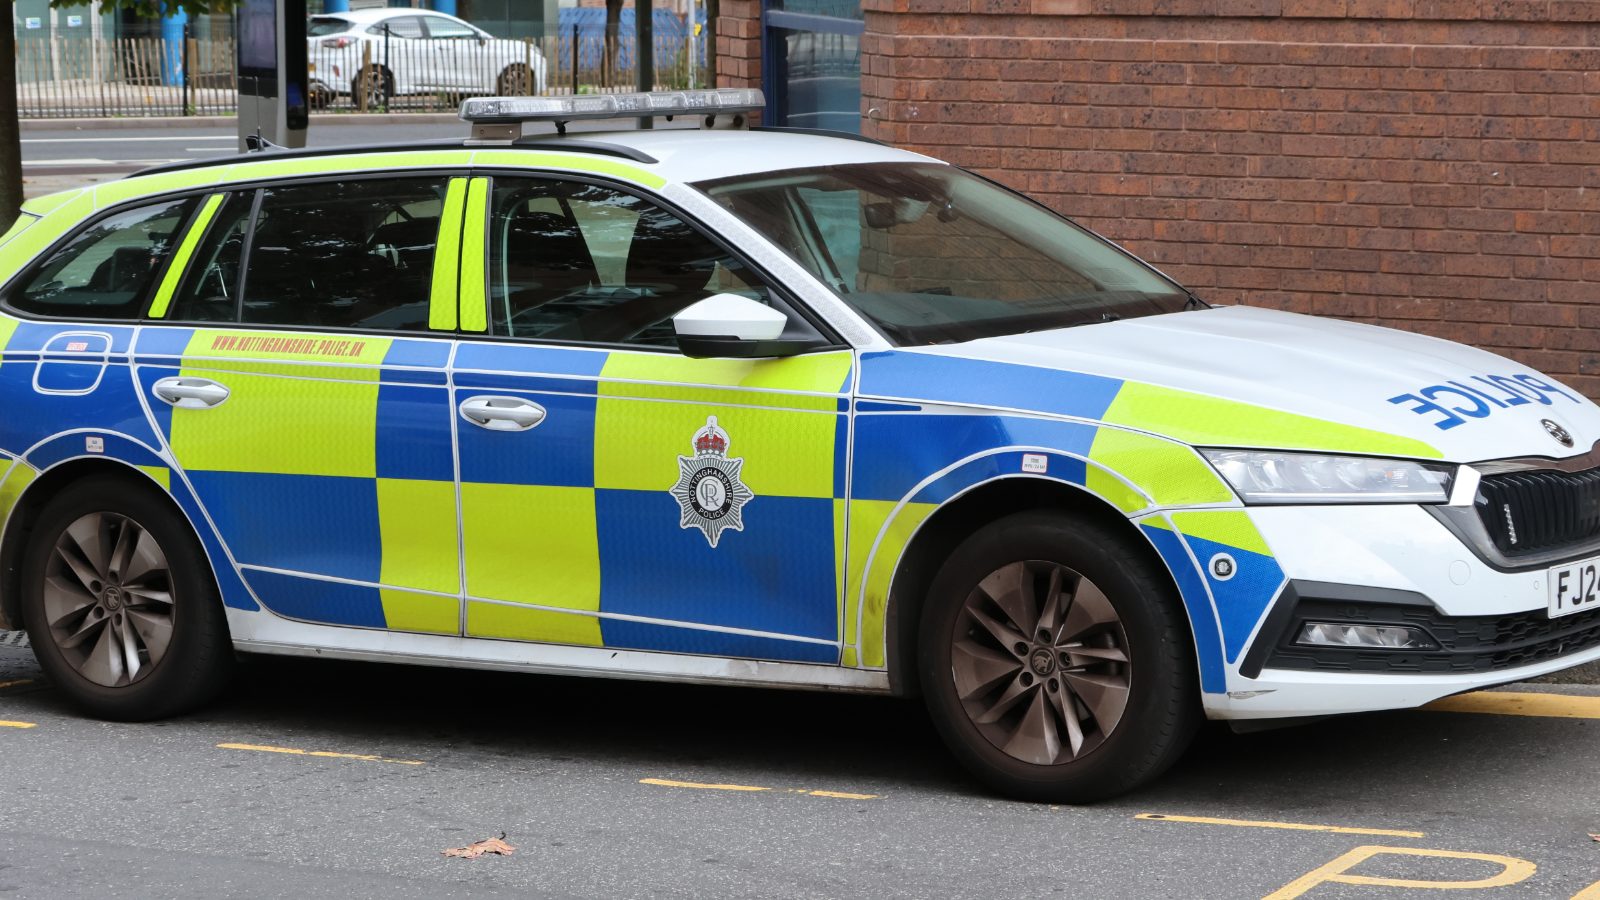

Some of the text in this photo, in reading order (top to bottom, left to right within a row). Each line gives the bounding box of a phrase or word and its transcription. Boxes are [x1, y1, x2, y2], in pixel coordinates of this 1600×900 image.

[689, 468, 733, 504] NOTTINGHAMSHIRE
[698, 507, 726, 519] POLICE
[1557, 565, 1600, 609] FJ2
